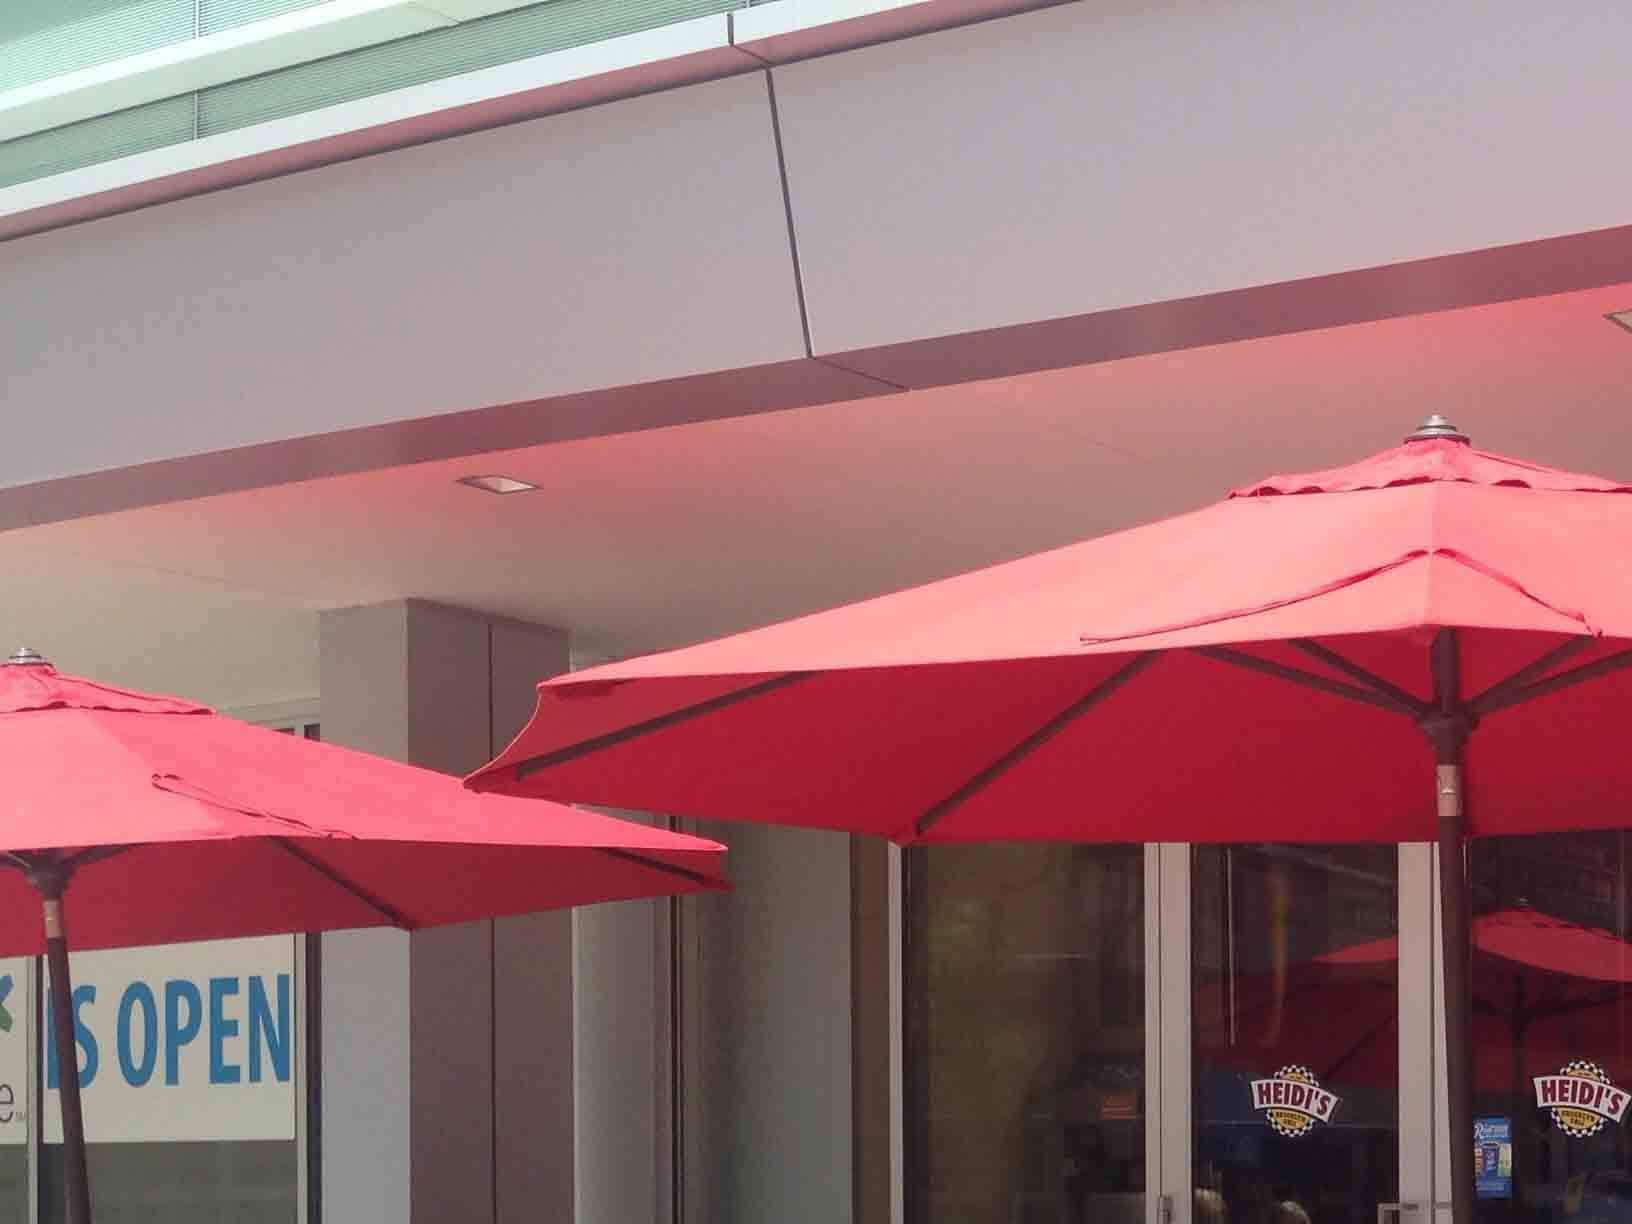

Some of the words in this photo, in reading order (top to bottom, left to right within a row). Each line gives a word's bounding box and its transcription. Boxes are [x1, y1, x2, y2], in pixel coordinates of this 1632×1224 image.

[116, 973, 290, 1088] OPEN
[1257, 1082, 1332, 1116] HEIDI'S
[1540, 1079, 1623, 1115] HEIDI'S
